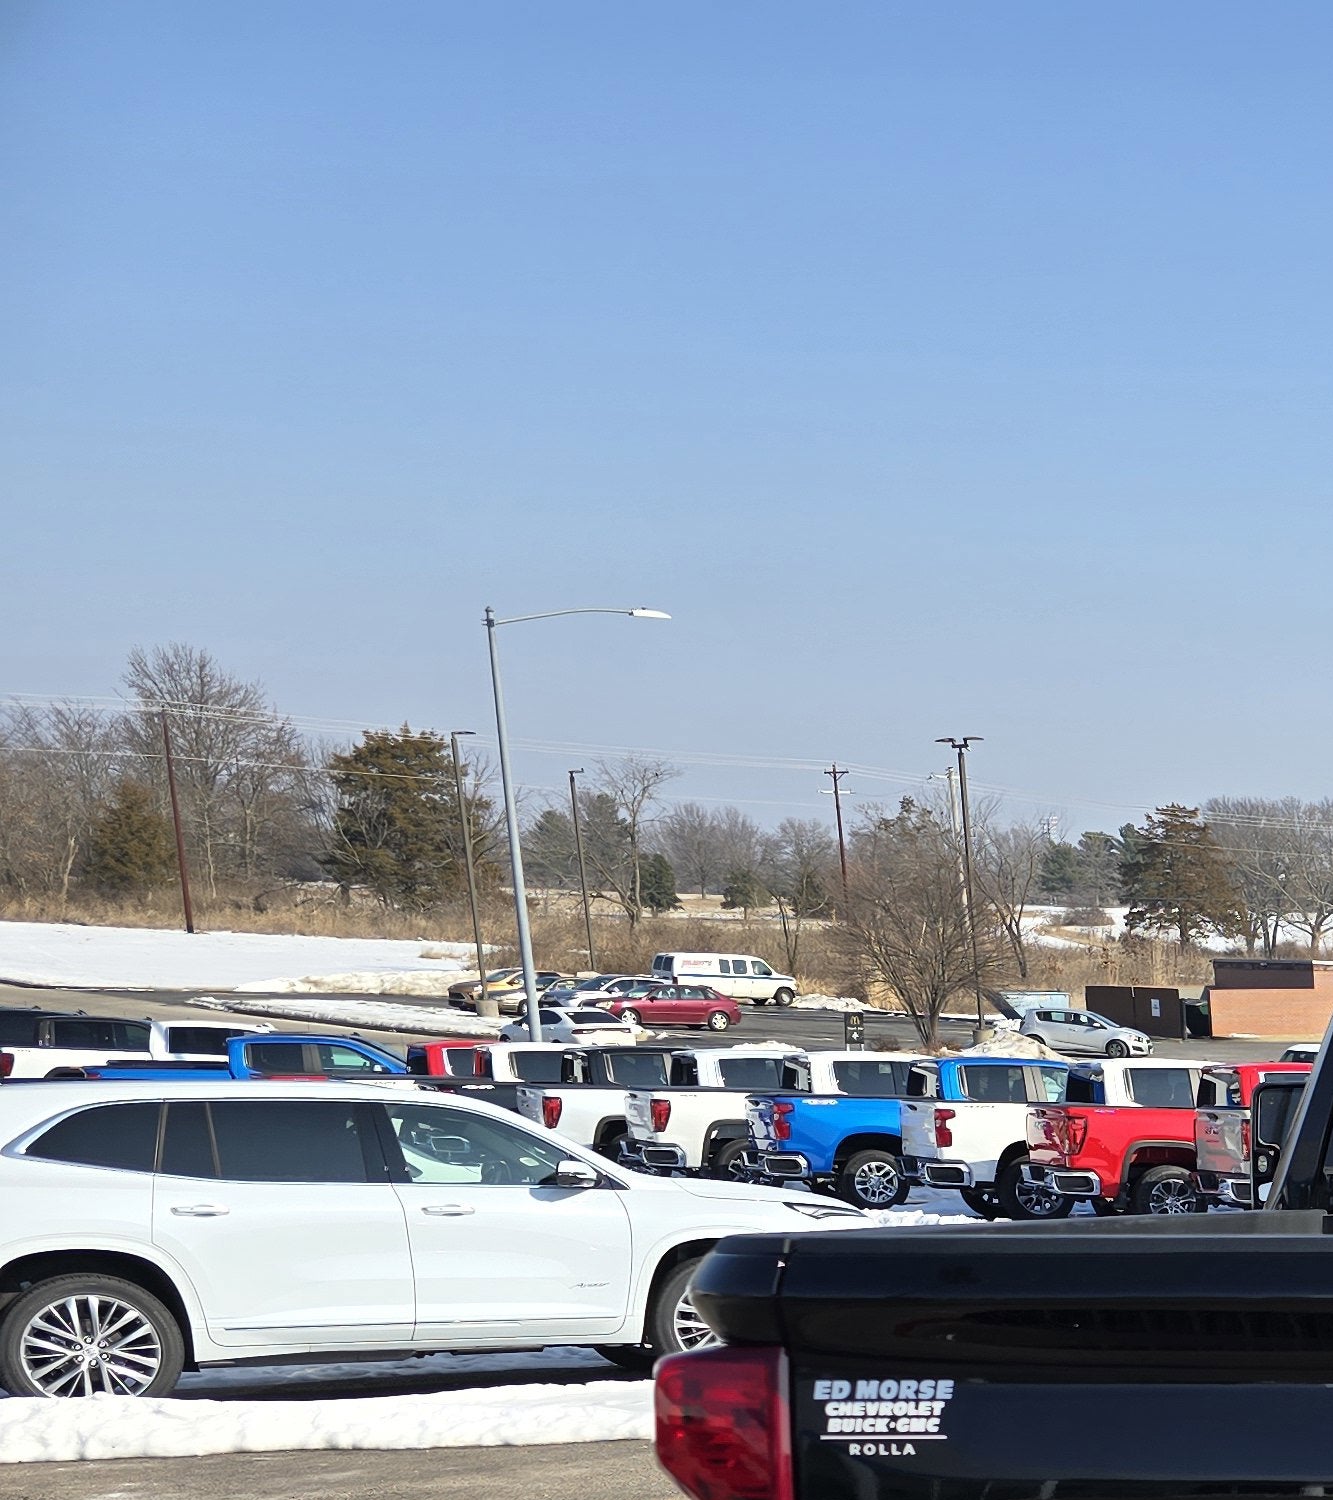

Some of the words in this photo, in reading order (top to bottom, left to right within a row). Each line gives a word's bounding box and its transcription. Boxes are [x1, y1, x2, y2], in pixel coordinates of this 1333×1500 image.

[813, 1379, 852, 1400] ED
[855, 1379, 955, 1400] MORSE
[824, 1401, 946, 1416] CHEVROLET
[848, 1443, 917, 1456] ROLLA
